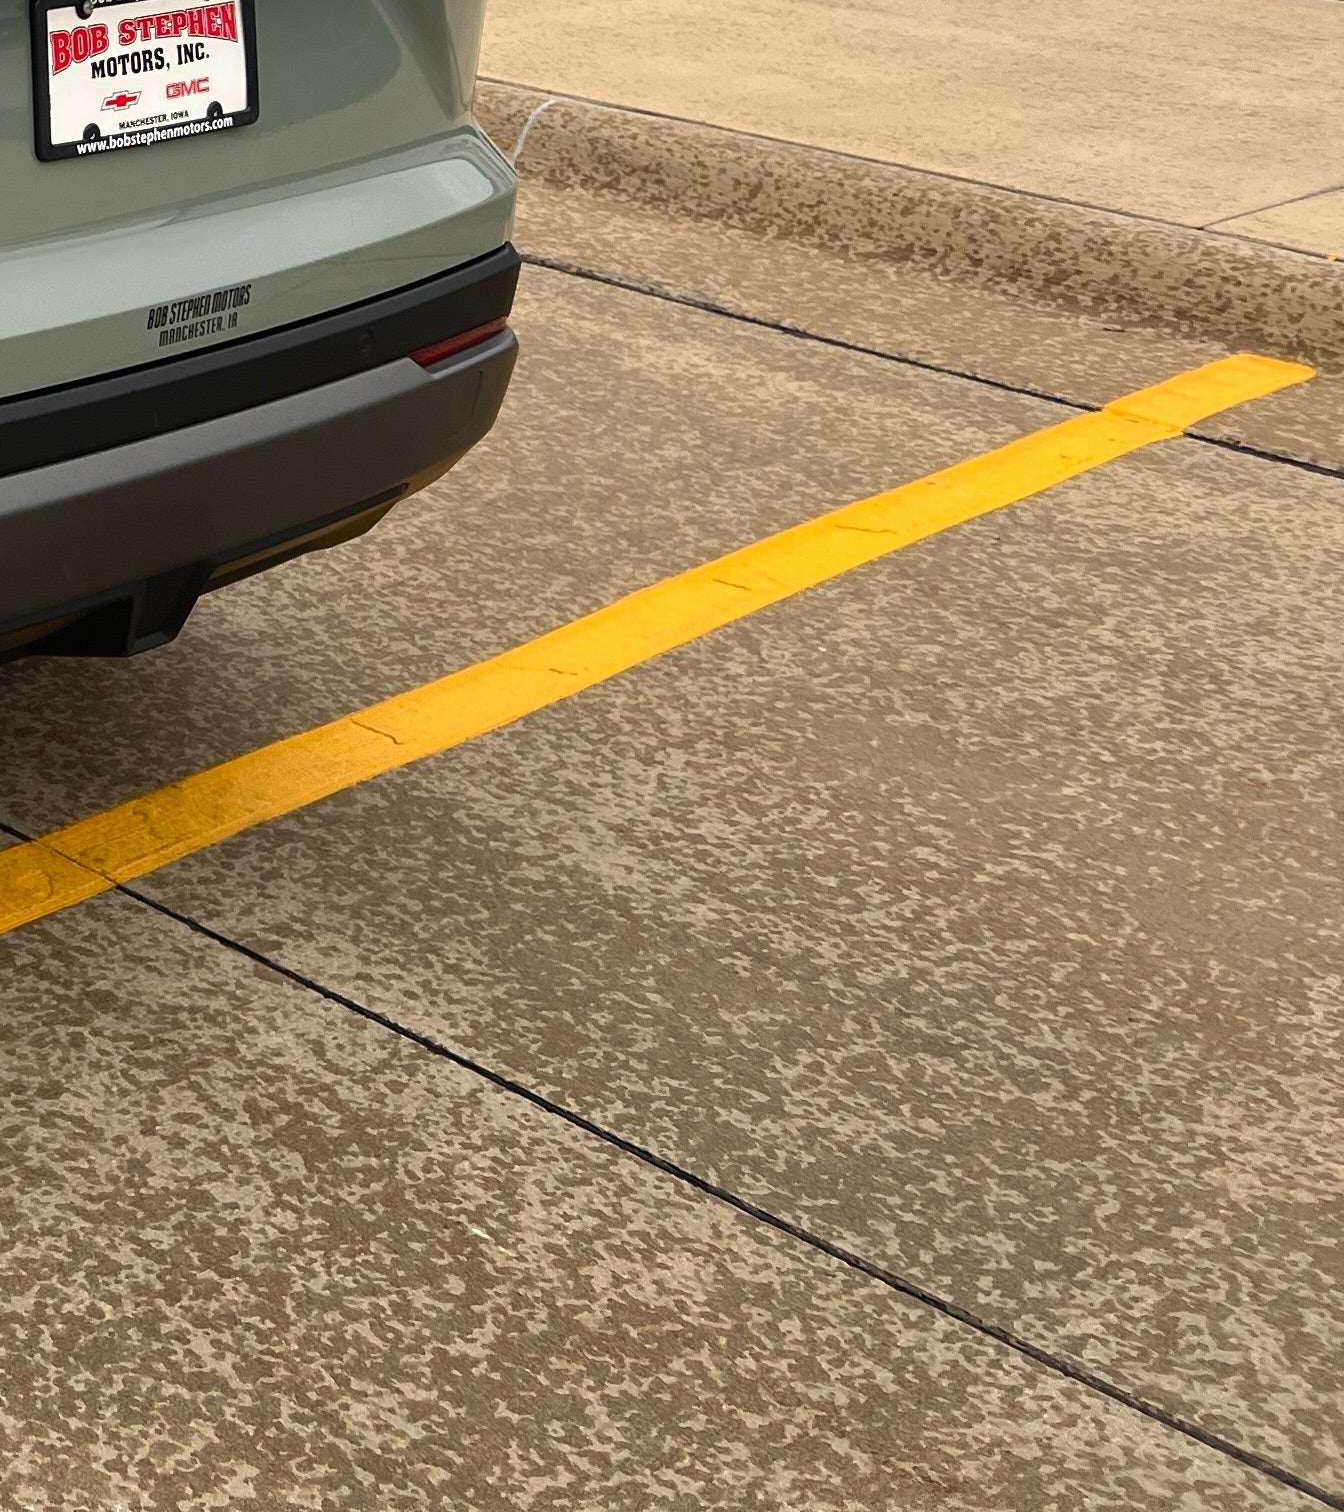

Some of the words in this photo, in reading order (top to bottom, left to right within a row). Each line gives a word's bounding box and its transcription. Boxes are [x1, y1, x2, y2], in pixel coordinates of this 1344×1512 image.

[50, 24, 109, 75] BOB
[118, 2, 238, 46] STEPHEN
[90, 47, 171, 80] MOTORS,
[177, 41, 210, 66] INC.
[166, 77, 210, 100] GMC
[76, 116, 233, 155] www.bobstephenmotors.com
[118, 113, 169, 131] MANCHESTER,
[170, 109, 190, 121] IOWA
[146, 306, 169, 330] BOB
[169, 295, 211, 325] STEPHEN
[212, 284, 251, 314] MOTORS
[227, 311, 239, 329] IA
